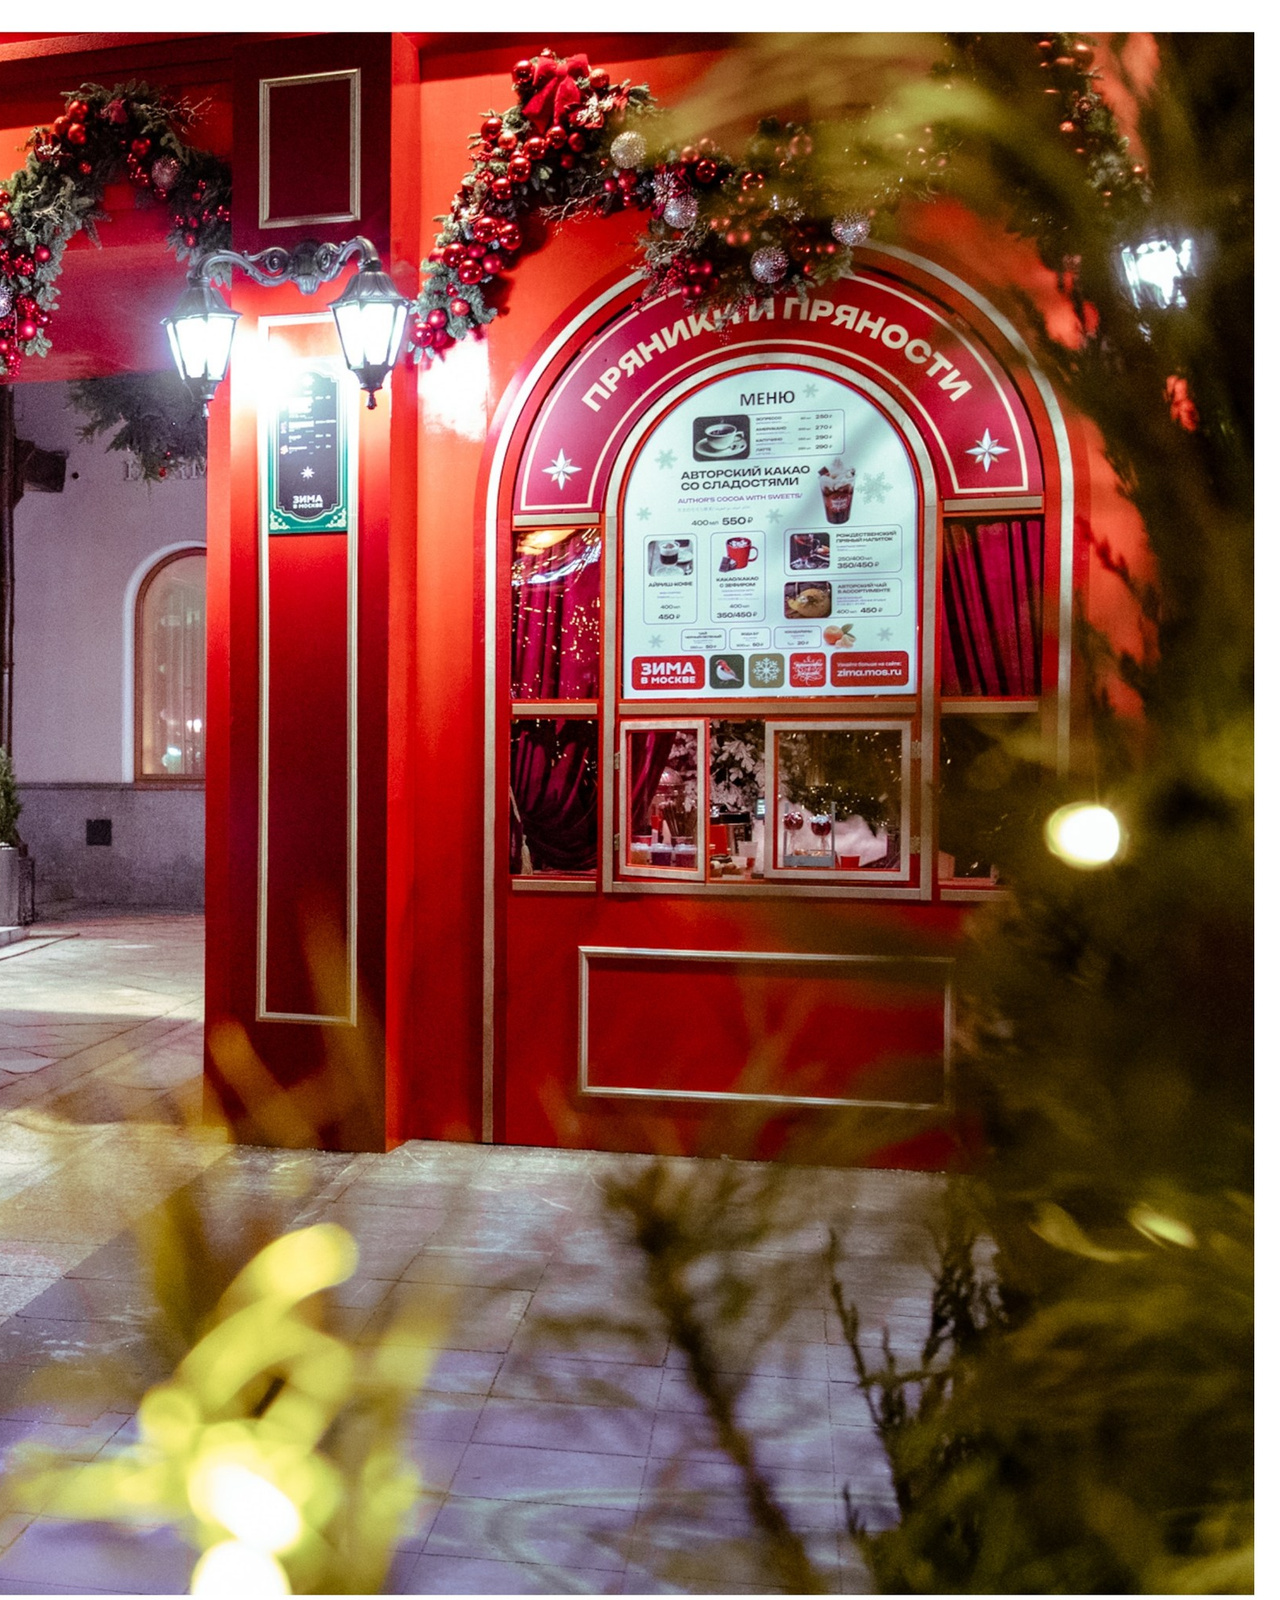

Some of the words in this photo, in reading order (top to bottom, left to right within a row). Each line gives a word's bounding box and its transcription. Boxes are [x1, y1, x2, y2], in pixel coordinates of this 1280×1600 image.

[783, 297, 972, 402] ПРЯНОСТИ
[740, 391, 795, 406] МЕНЮ
[681, 466, 761, 480] АВТОРСКИЙ
[764, 465, 810, 476] КАКАО
[681, 482, 700, 491] СО
[702, 477, 799, 490] СЛАДОСТЯМИ
[293, 495, 323, 504] ЗИМА
[641, 661, 696, 675] ЗИМА
[837, 667, 902, 677] zima.mos.ru
[651, 676, 696, 684] МОСКВЕ
